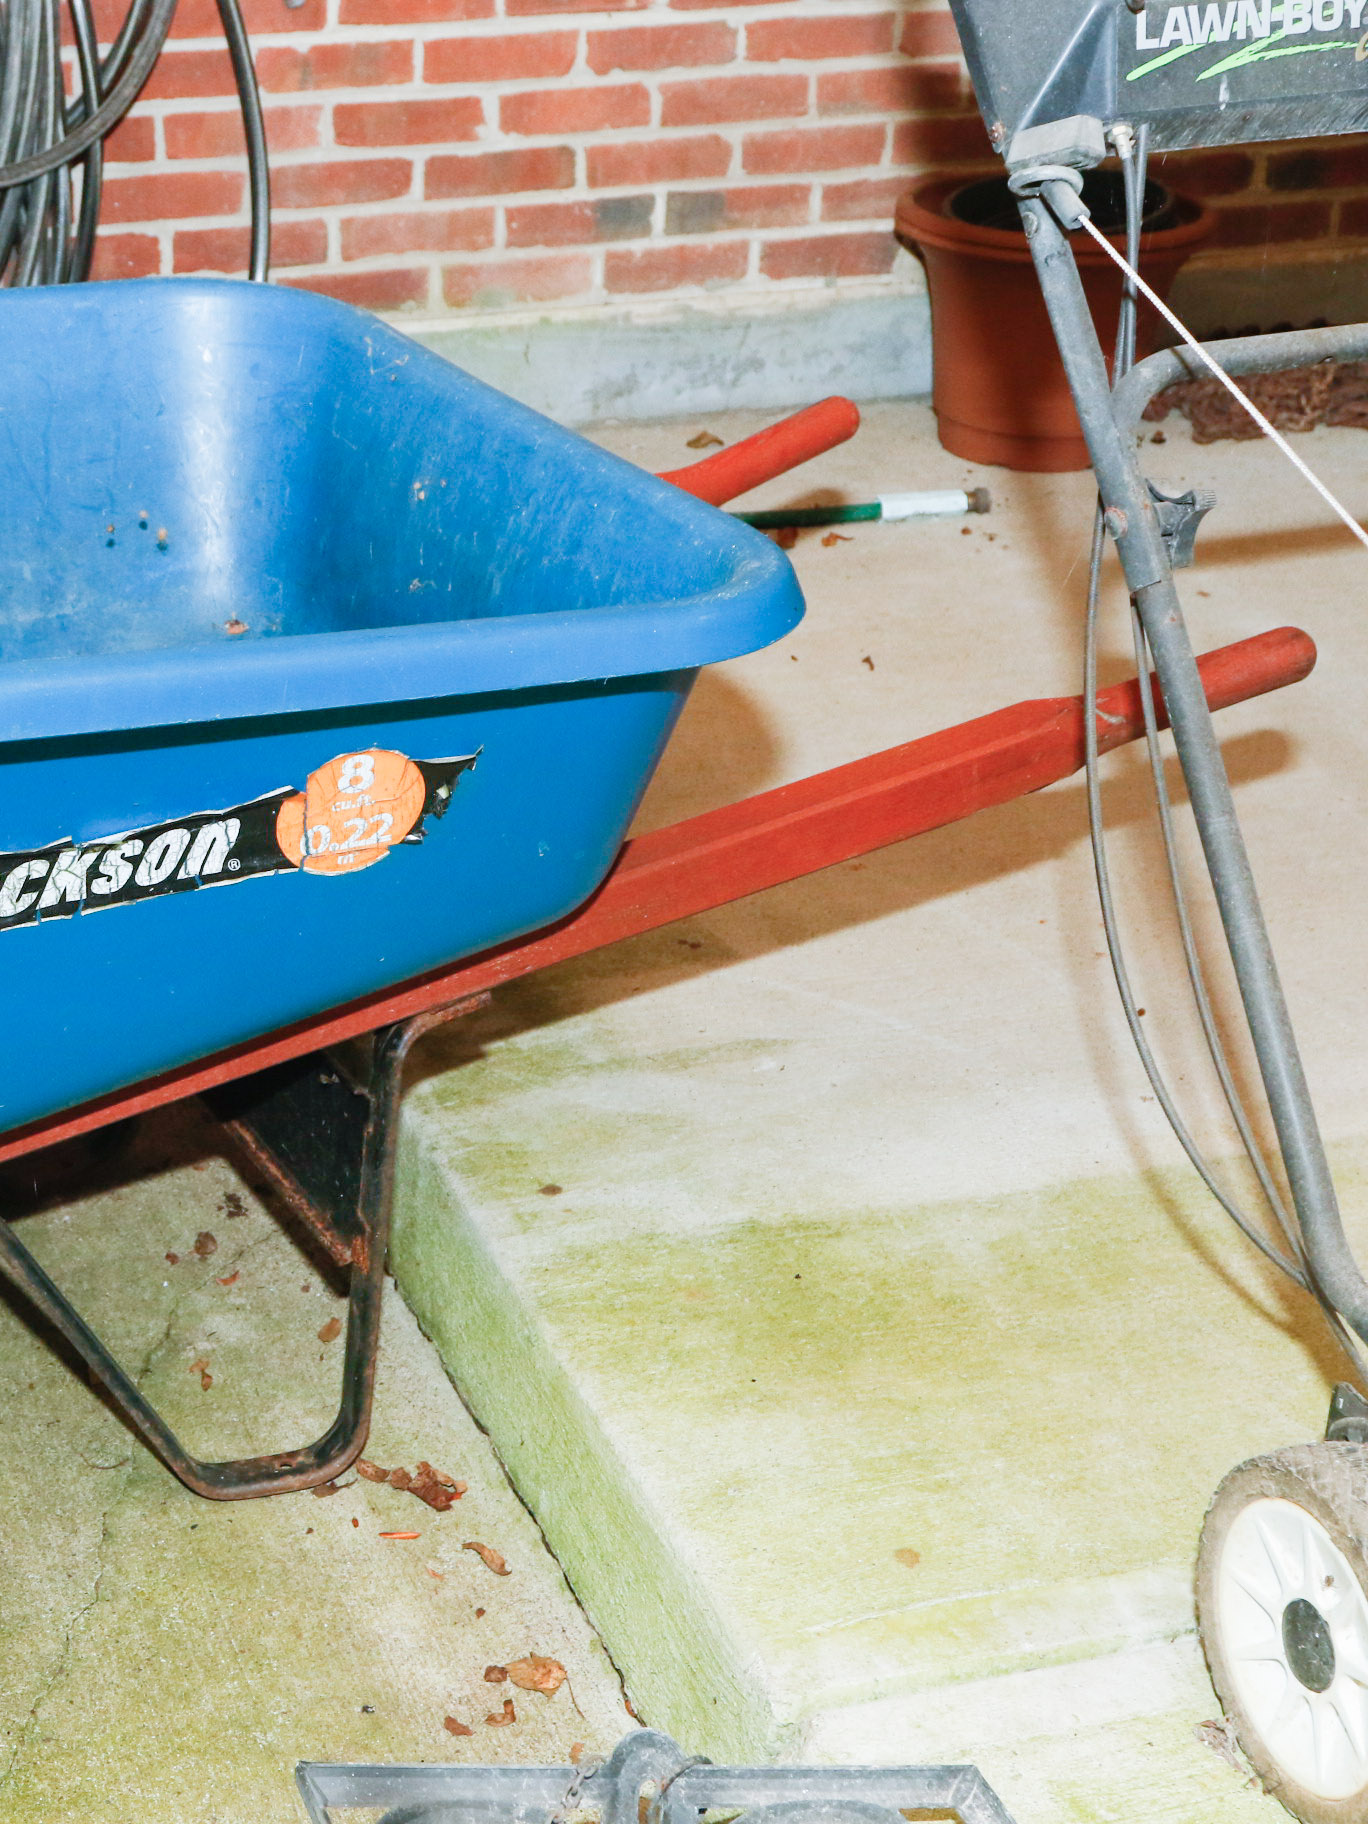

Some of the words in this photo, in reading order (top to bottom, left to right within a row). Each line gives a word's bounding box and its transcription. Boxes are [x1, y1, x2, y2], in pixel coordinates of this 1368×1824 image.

[1136, 0, 1368, 49] LAWN-BOY
[338, 754, 375, 794] 8
[300, 812, 394, 855] 0.22
